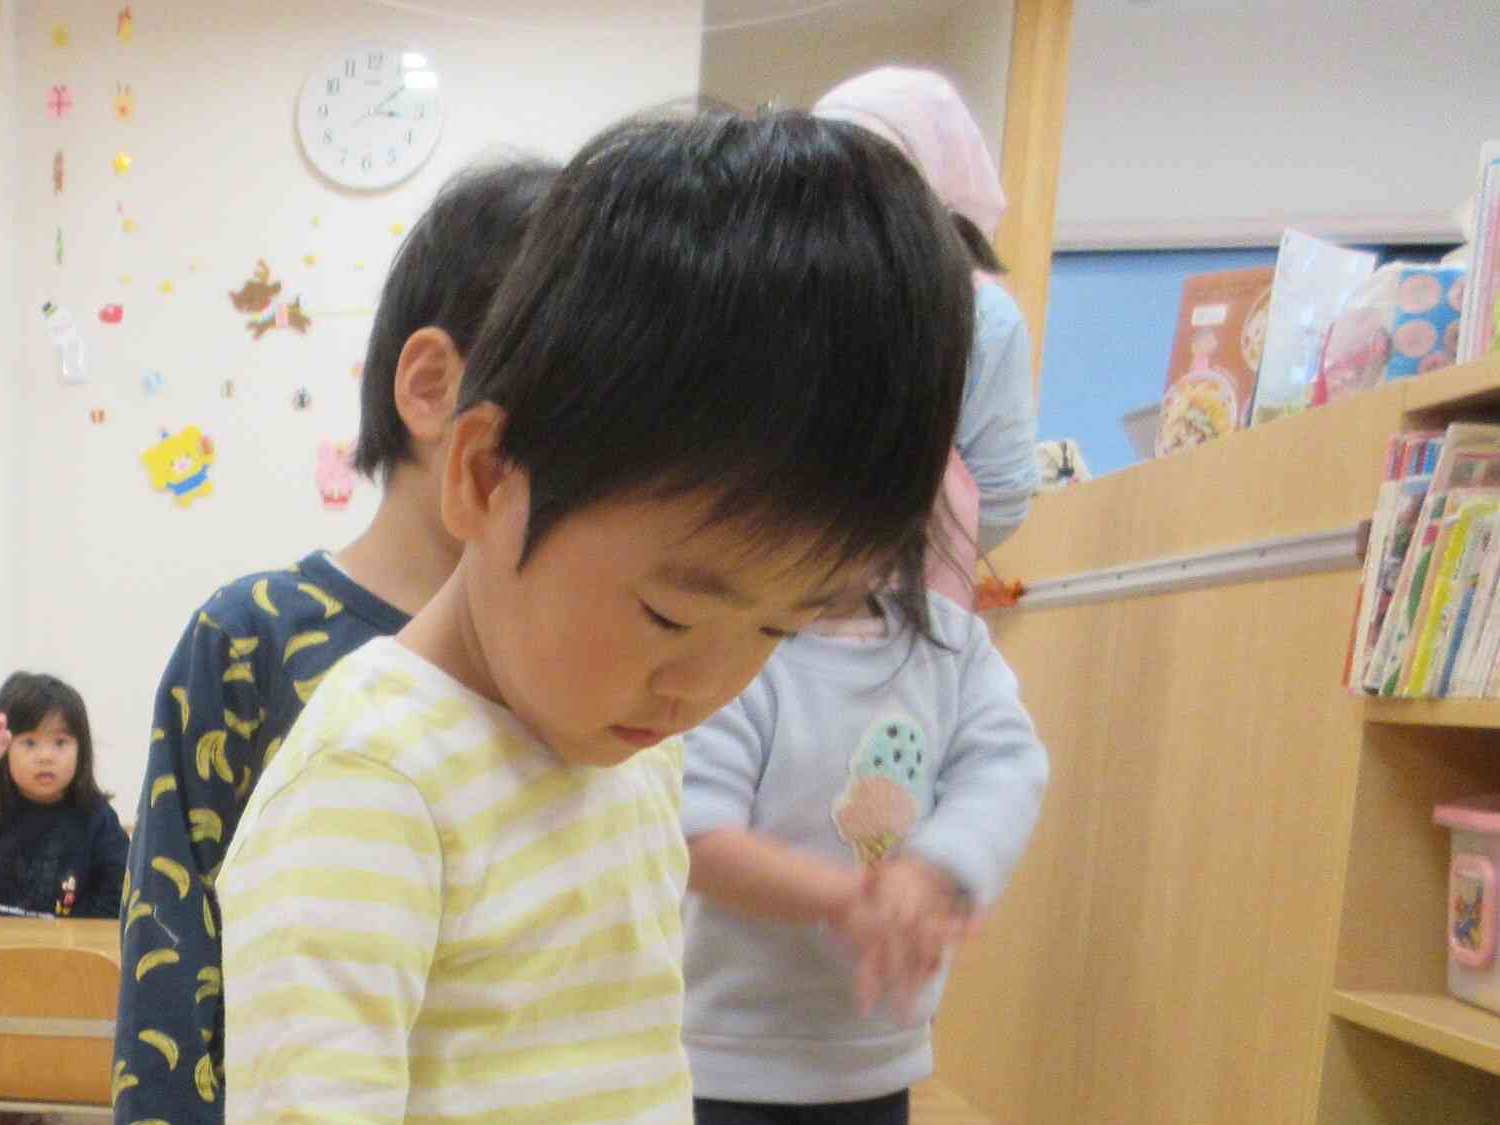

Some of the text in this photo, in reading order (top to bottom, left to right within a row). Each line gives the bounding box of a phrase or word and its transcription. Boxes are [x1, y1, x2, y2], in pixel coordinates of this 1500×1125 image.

[344, 58, 357, 78] 11
[366, 51, 384, 72] 12
[325, 79, 341, 95] 10
[317, 104, 329, 121] 9
[322, 128, 333, 145] 8
[403, 128, 414, 145] 4
